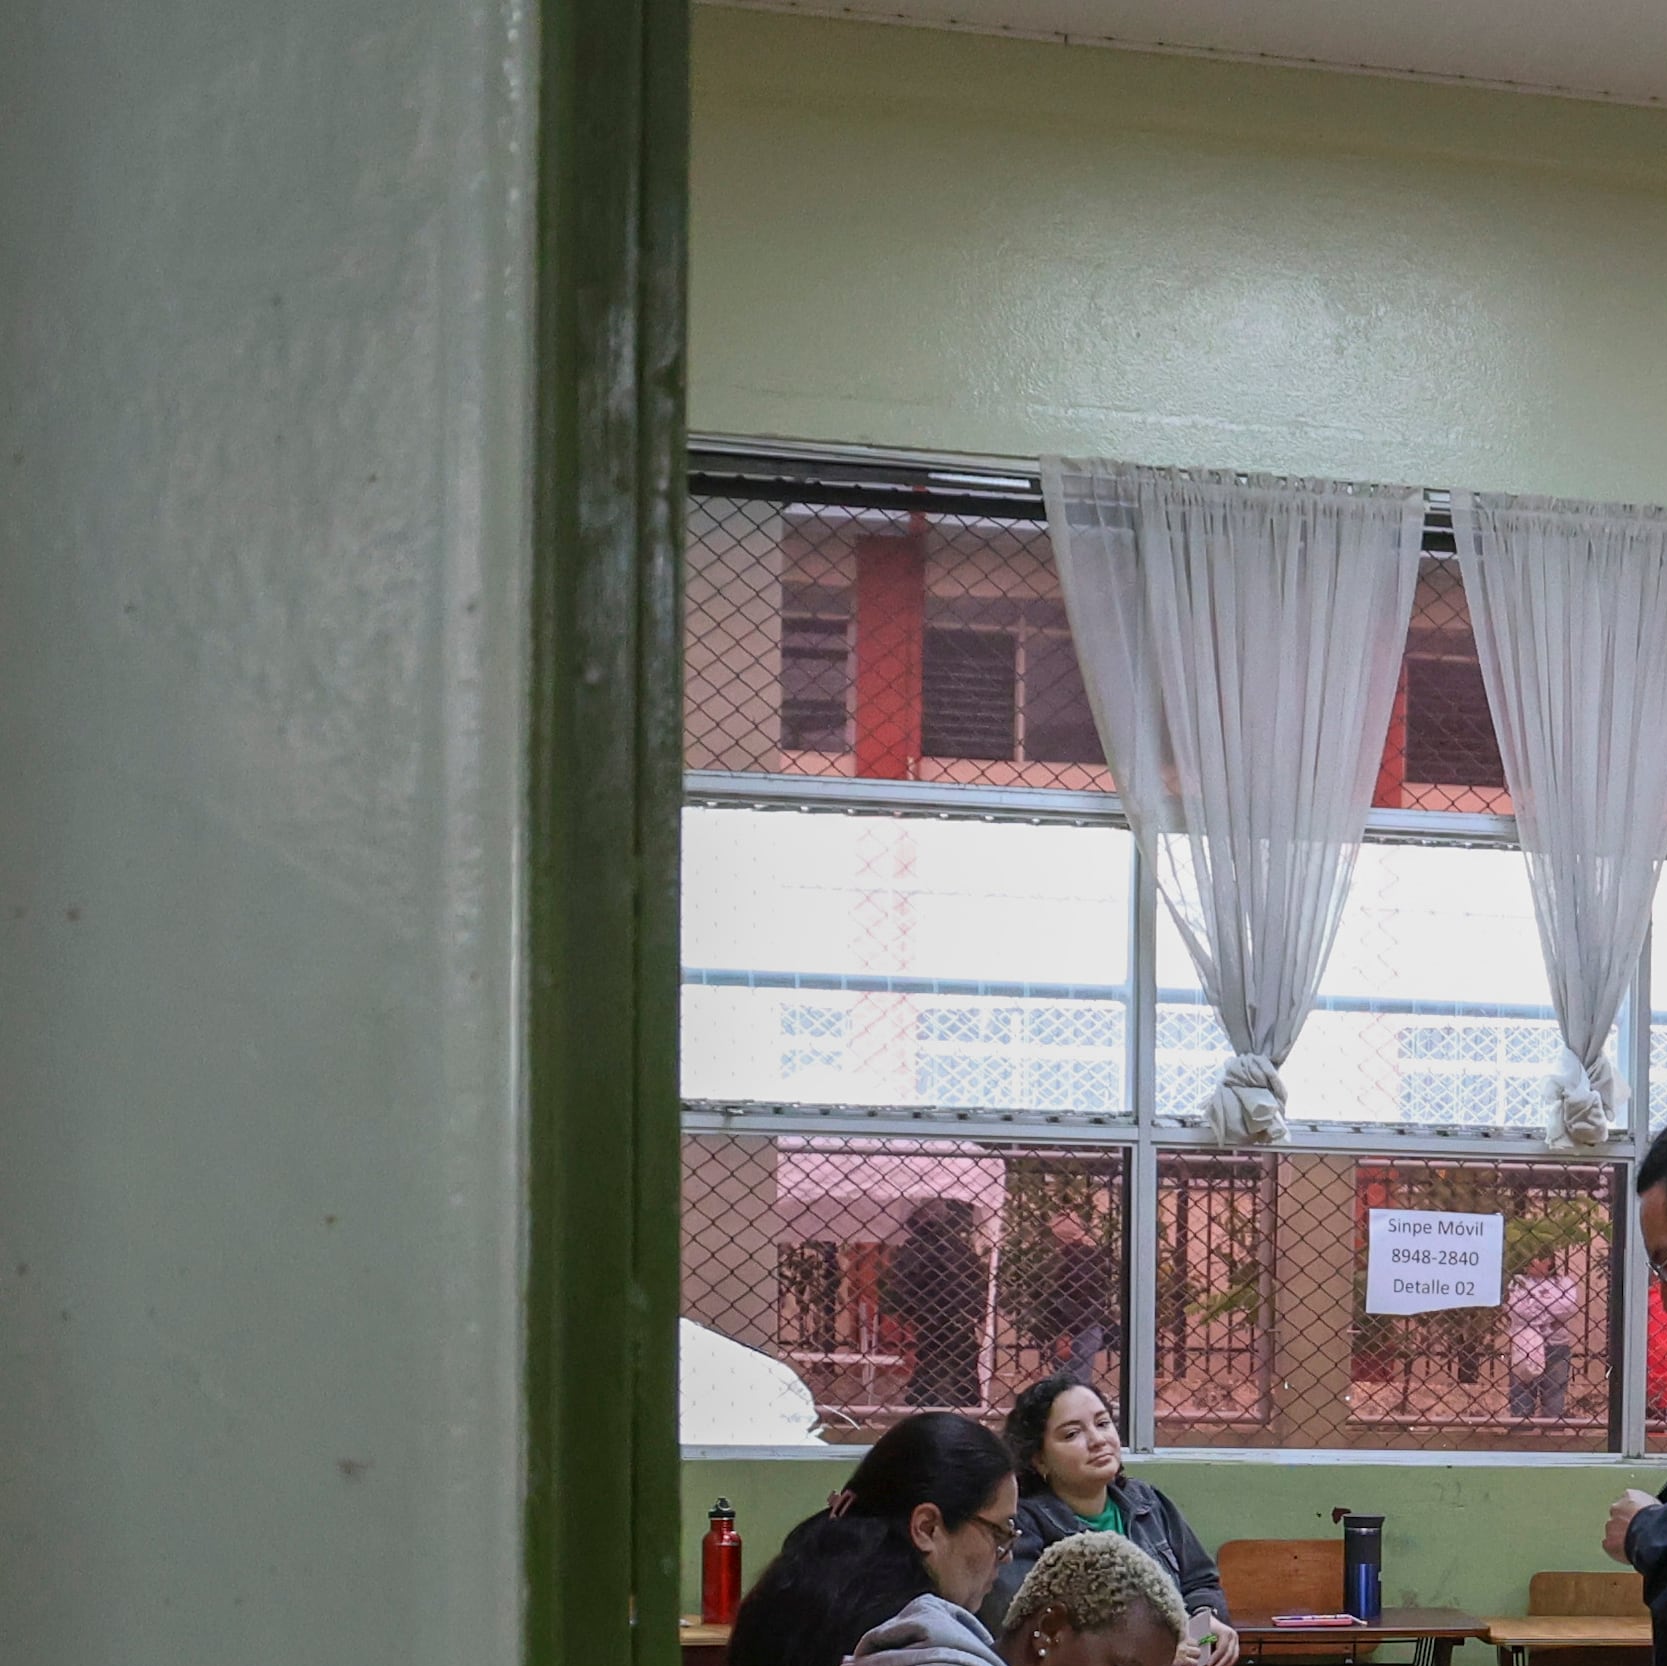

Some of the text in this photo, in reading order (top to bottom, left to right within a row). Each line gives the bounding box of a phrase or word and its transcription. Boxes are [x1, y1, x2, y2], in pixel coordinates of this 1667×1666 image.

[1388, 1217, 1484, 1237] Sinpe Móvil
[1391, 1248, 1480, 1266] 8948-2840
[1393, 1278, 1475, 1296] Detalle 02
